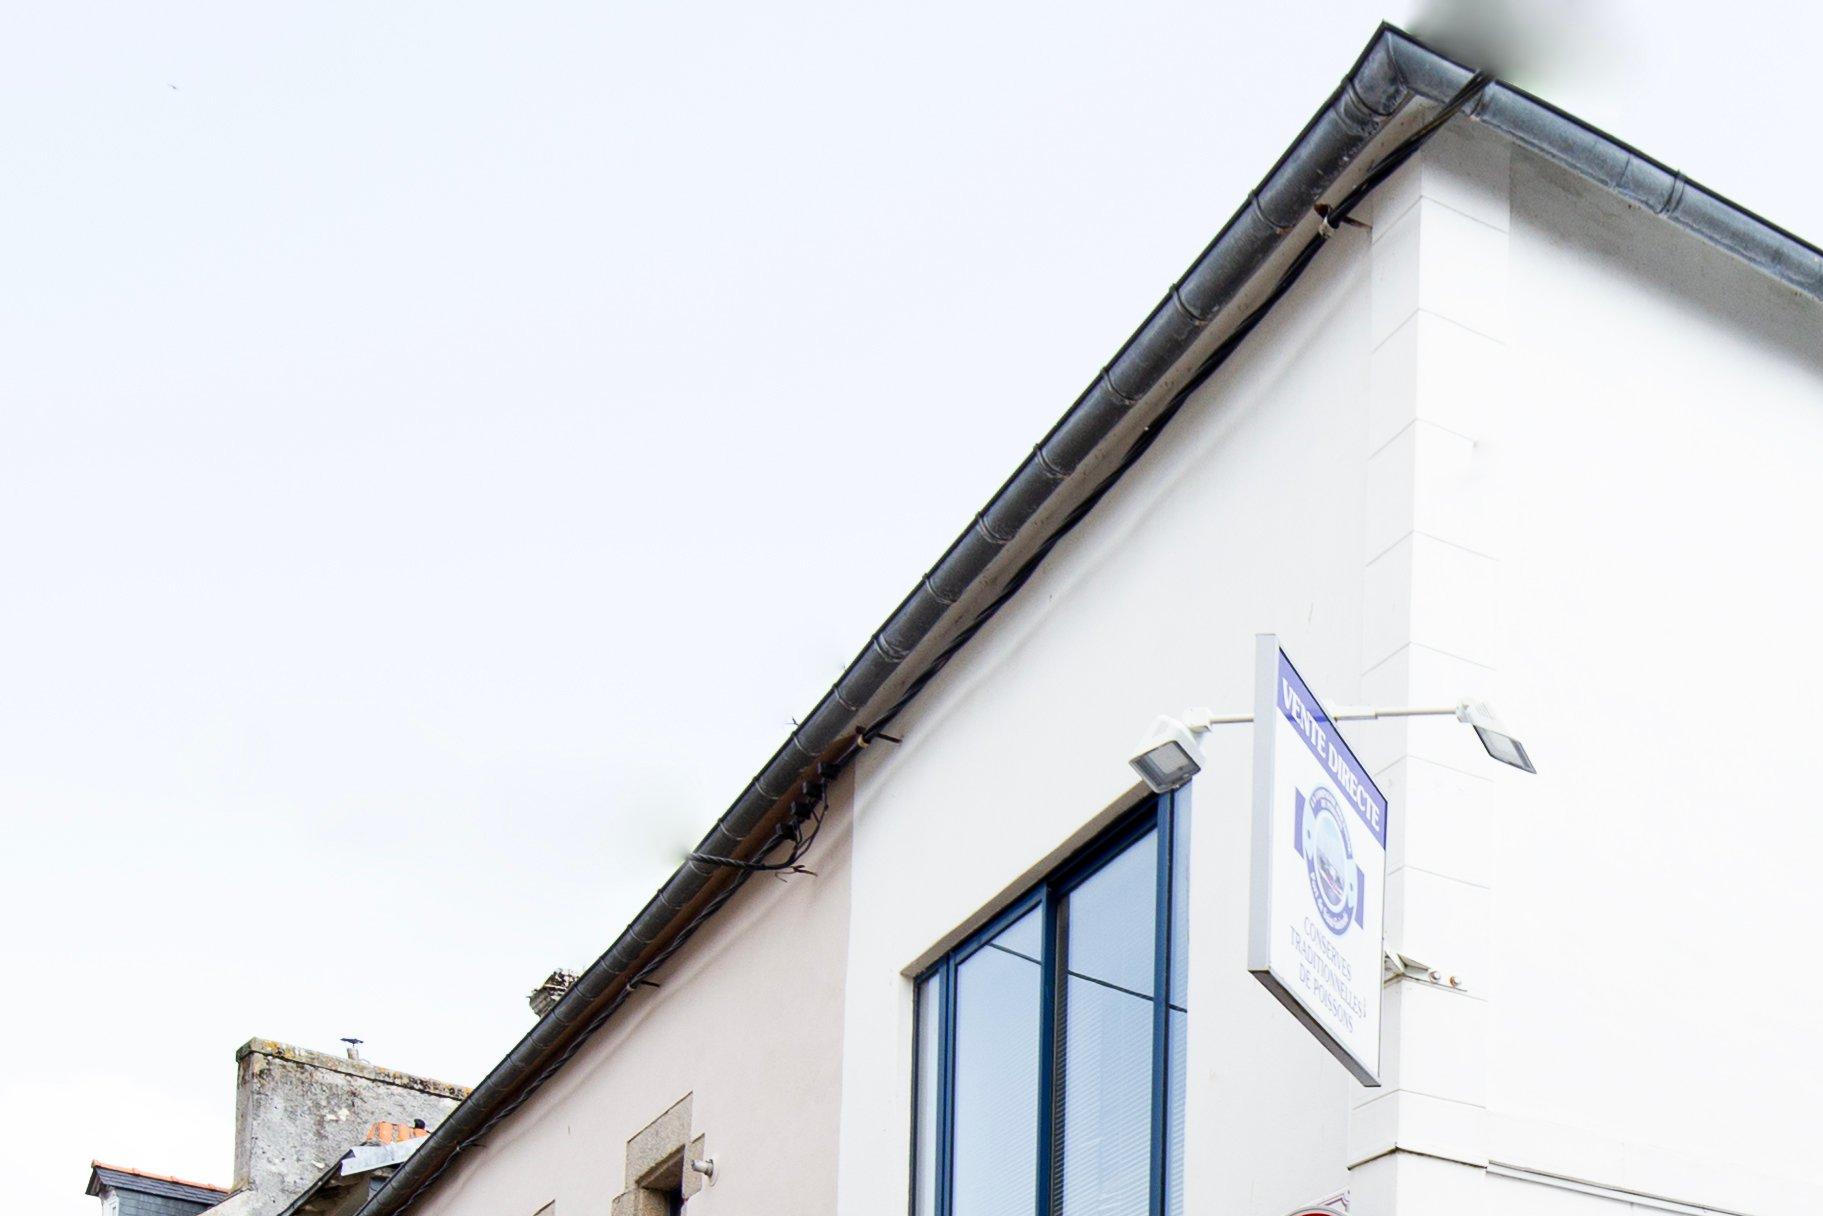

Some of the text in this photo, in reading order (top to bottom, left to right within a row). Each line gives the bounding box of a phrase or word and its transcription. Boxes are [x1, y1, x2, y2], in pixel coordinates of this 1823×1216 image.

[1282, 677, 1326, 758] VENTE
[1328, 742, 1380, 832] DIRECTE
[1300, 962, 1311, 990] DE
[1304, 916, 1352, 981] CONSERVES
